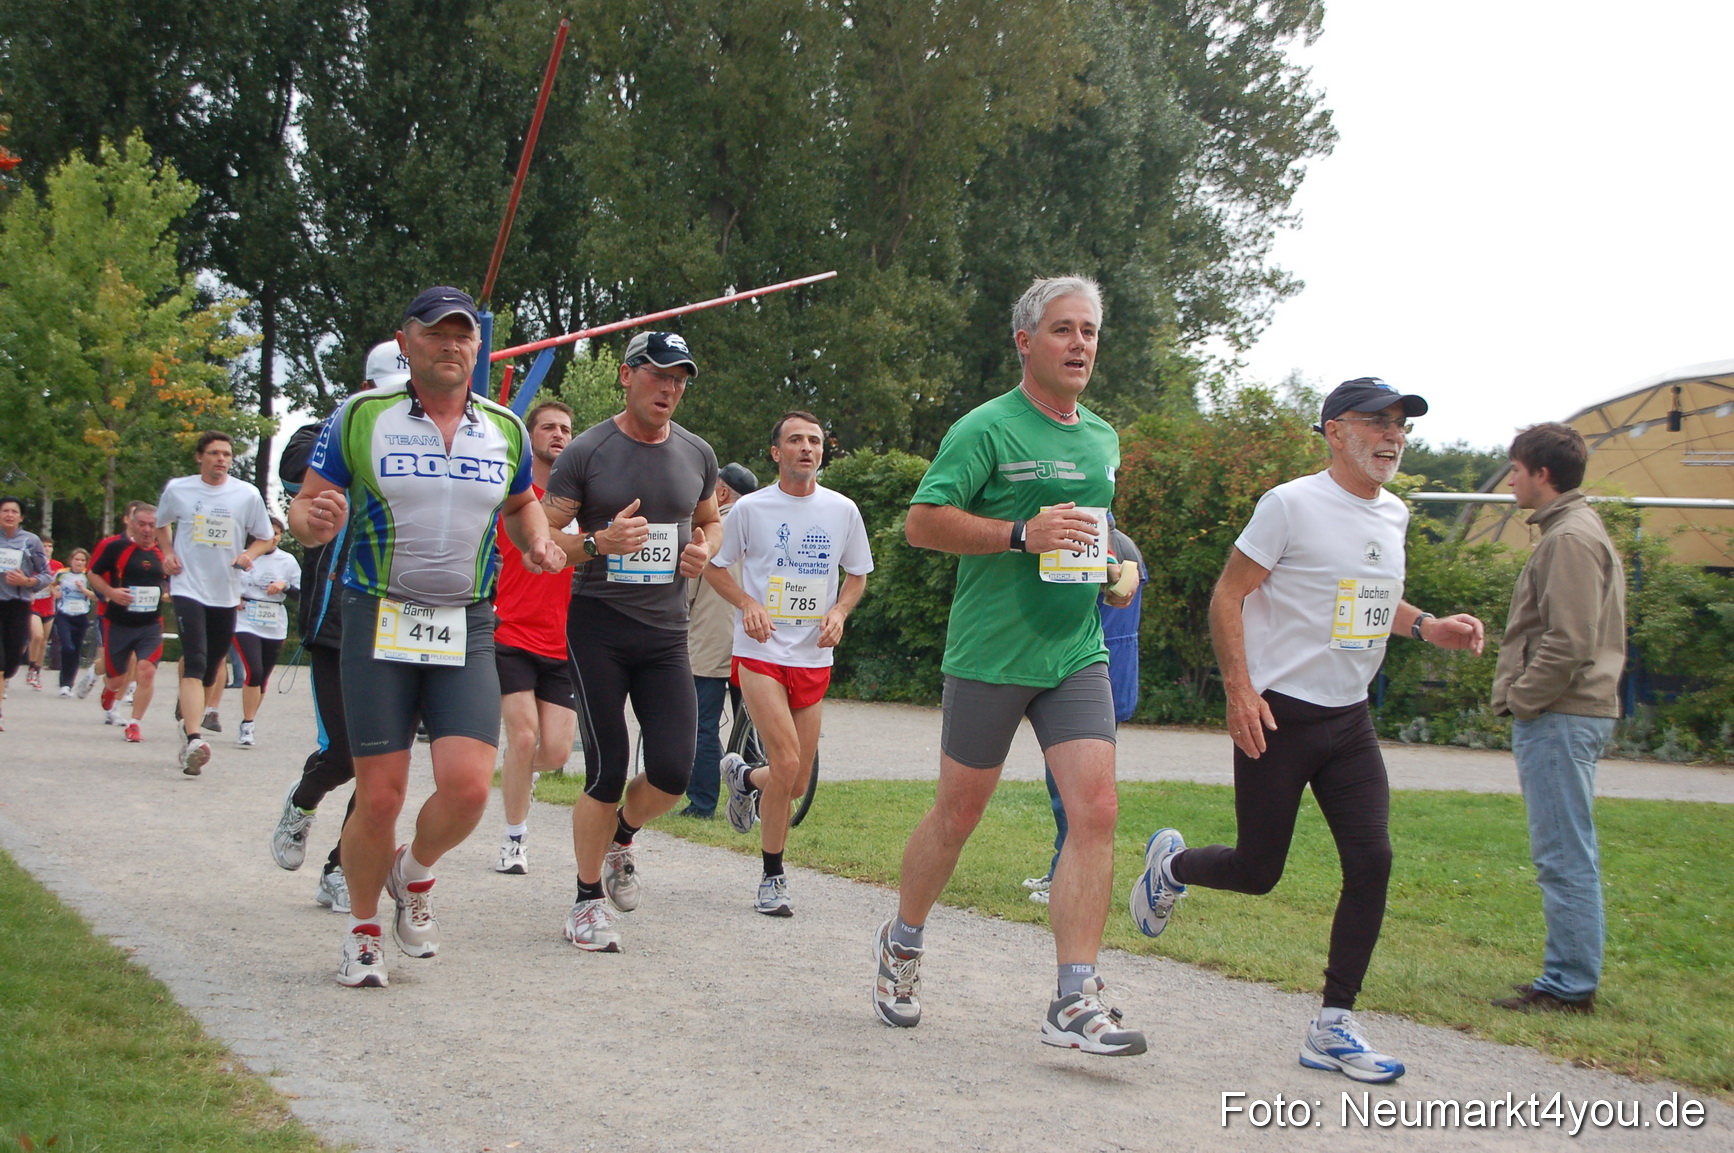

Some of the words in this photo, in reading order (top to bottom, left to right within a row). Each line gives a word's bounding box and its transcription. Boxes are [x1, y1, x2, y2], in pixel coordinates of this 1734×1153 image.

[385, 434, 439, 447] TEAM
[381, 453, 505, 484] BOCK
[208, 528, 228, 538] 927
[629, 546, 671, 563] 2652
[776, 557, 787, 567] 8.
[788, 560, 830, 569] Neumarkter
[797, 567, 829, 575] Stadtlauf
[785, 581, 807, 593] Peter
[1357, 585, 1389, 599] Jochen
[769, 594, 775, 602] C
[790, 597, 817, 611] 785
[403, 601, 435, 620] Barny
[1339, 605, 1345, 616] C
[381, 617, 388, 628] B
[1364, 607, 1390, 627] 190
[409, 623, 452, 644] 414
[1071, 964, 1091, 973] TECH
